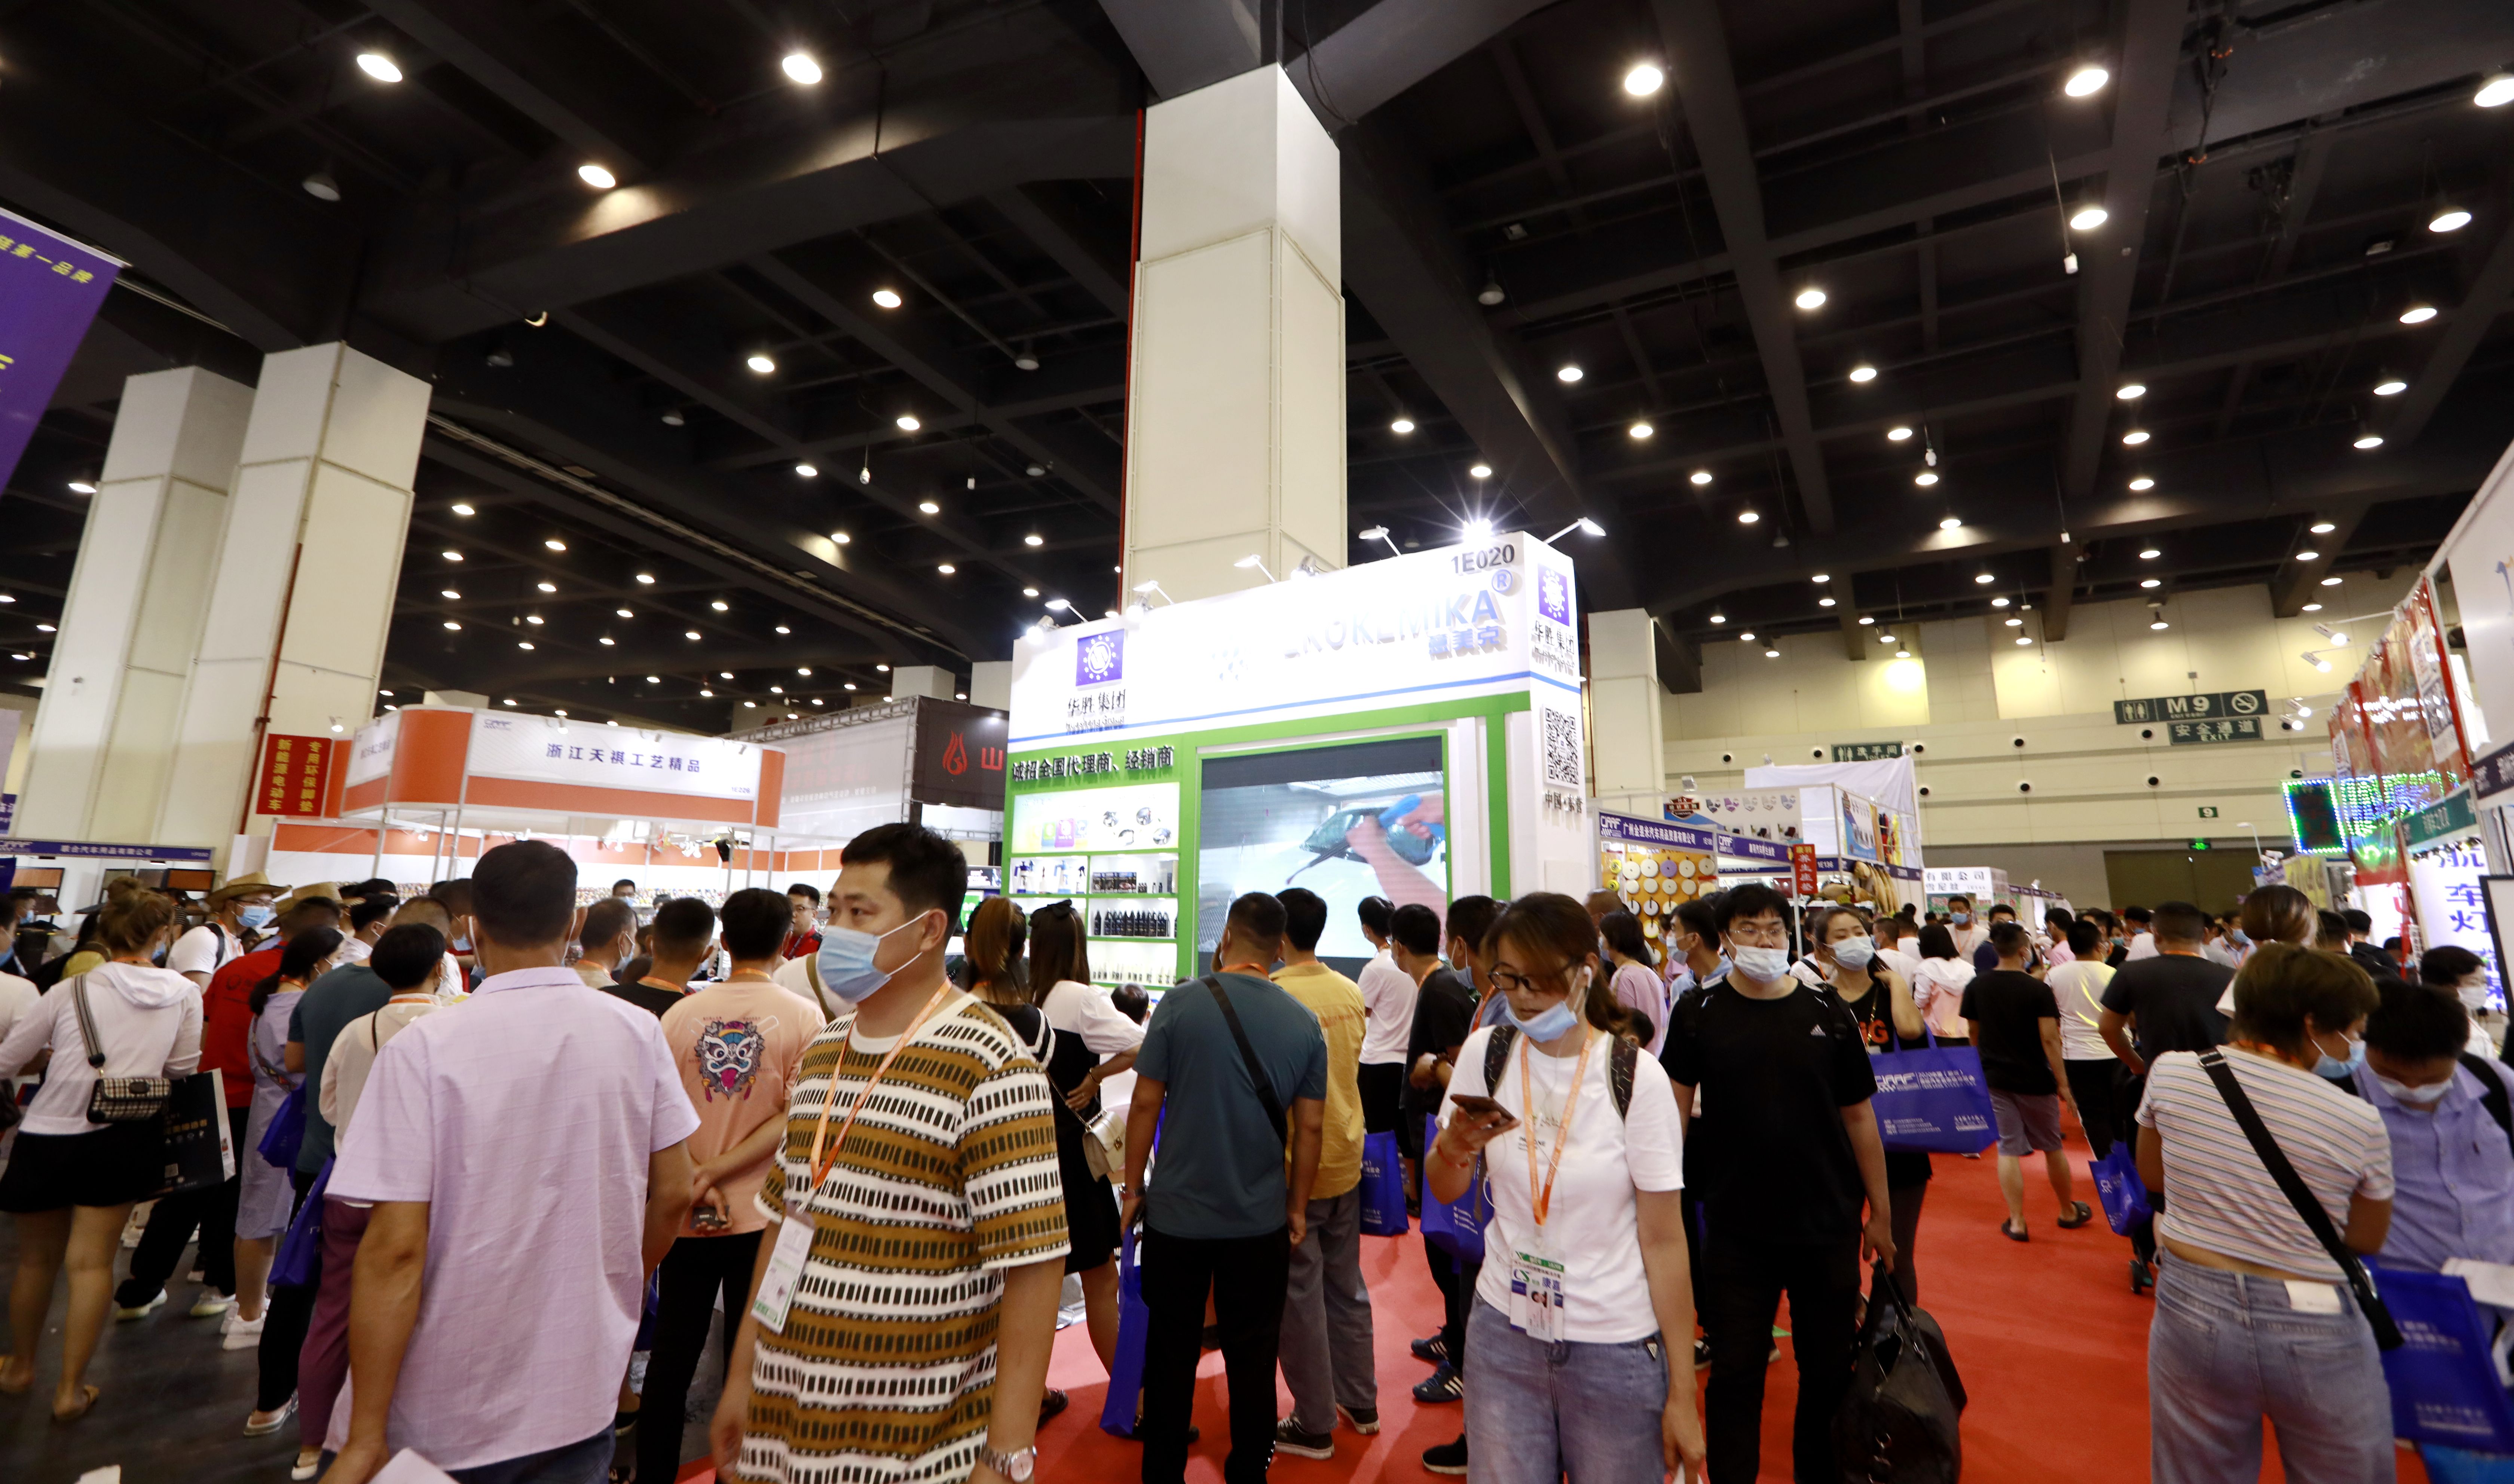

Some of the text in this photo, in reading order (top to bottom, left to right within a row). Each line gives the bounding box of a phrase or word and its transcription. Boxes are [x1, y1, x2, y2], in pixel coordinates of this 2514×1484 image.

[1451, 544, 1515, 575] 1E020
[1534, 620, 1574, 655] 华胜集团
[1068, 689, 1125, 717] 华胜集团
[2175, 720, 2255, 737] 安全通道
[2200, 733, 2230, 742] EXIT
[2203, 808, 2214, 817] 9
[1927, 871, 1984, 881] 有限公司
